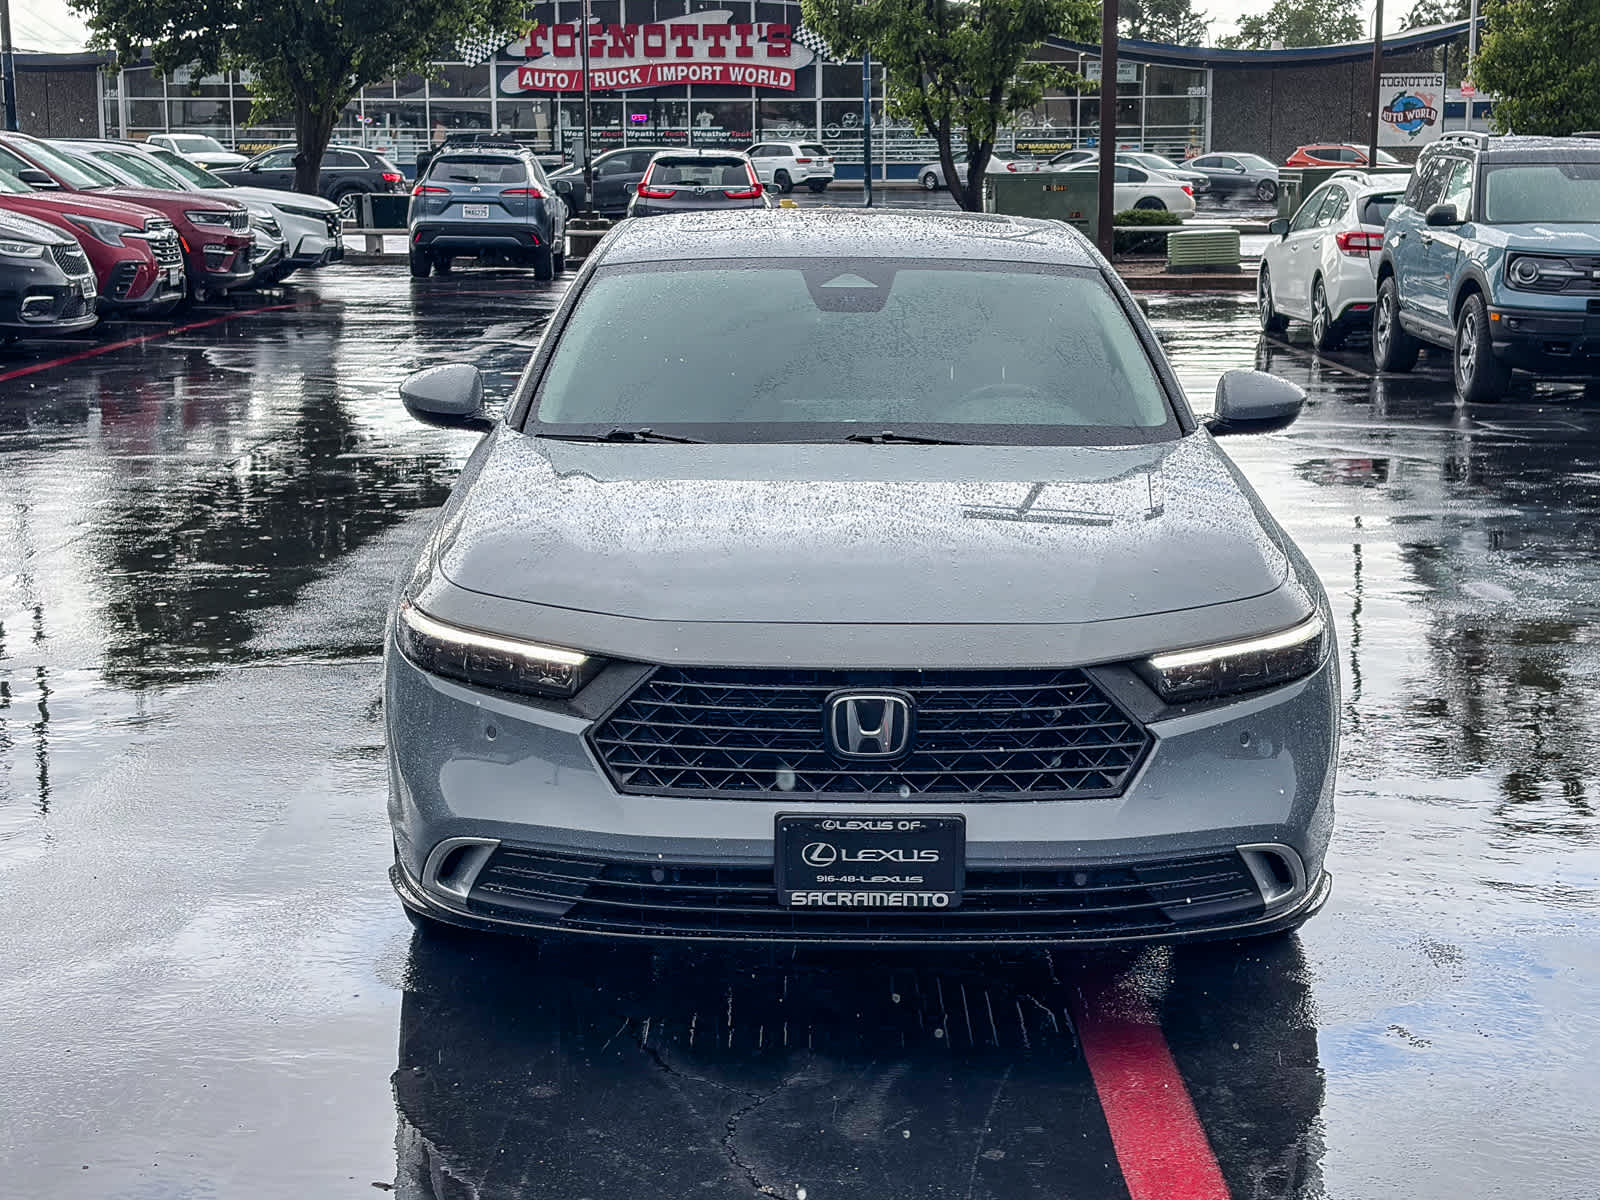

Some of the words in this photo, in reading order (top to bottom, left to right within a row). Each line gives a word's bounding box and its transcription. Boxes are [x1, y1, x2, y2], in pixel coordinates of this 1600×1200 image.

[520, 23, 792, 58] TOGNOTTI'S
[522, 71, 569, 88] AUTO
[589, 68, 642, 87] RUCK
[656, 65, 723, 82] IMPORT
[729, 66, 792, 87] WORLD
[1383, 110, 1403, 122] AUTO
[1406, 108, 1437, 121] WORLD
[836, 821, 894, 830] LEXUS
[897, 821, 921, 830] OF
[841, 849, 940, 862] LEXUS
[816, 875, 924, 883] 916-48-LEXUS
[791, 892, 949, 907] SACRAMENTO
